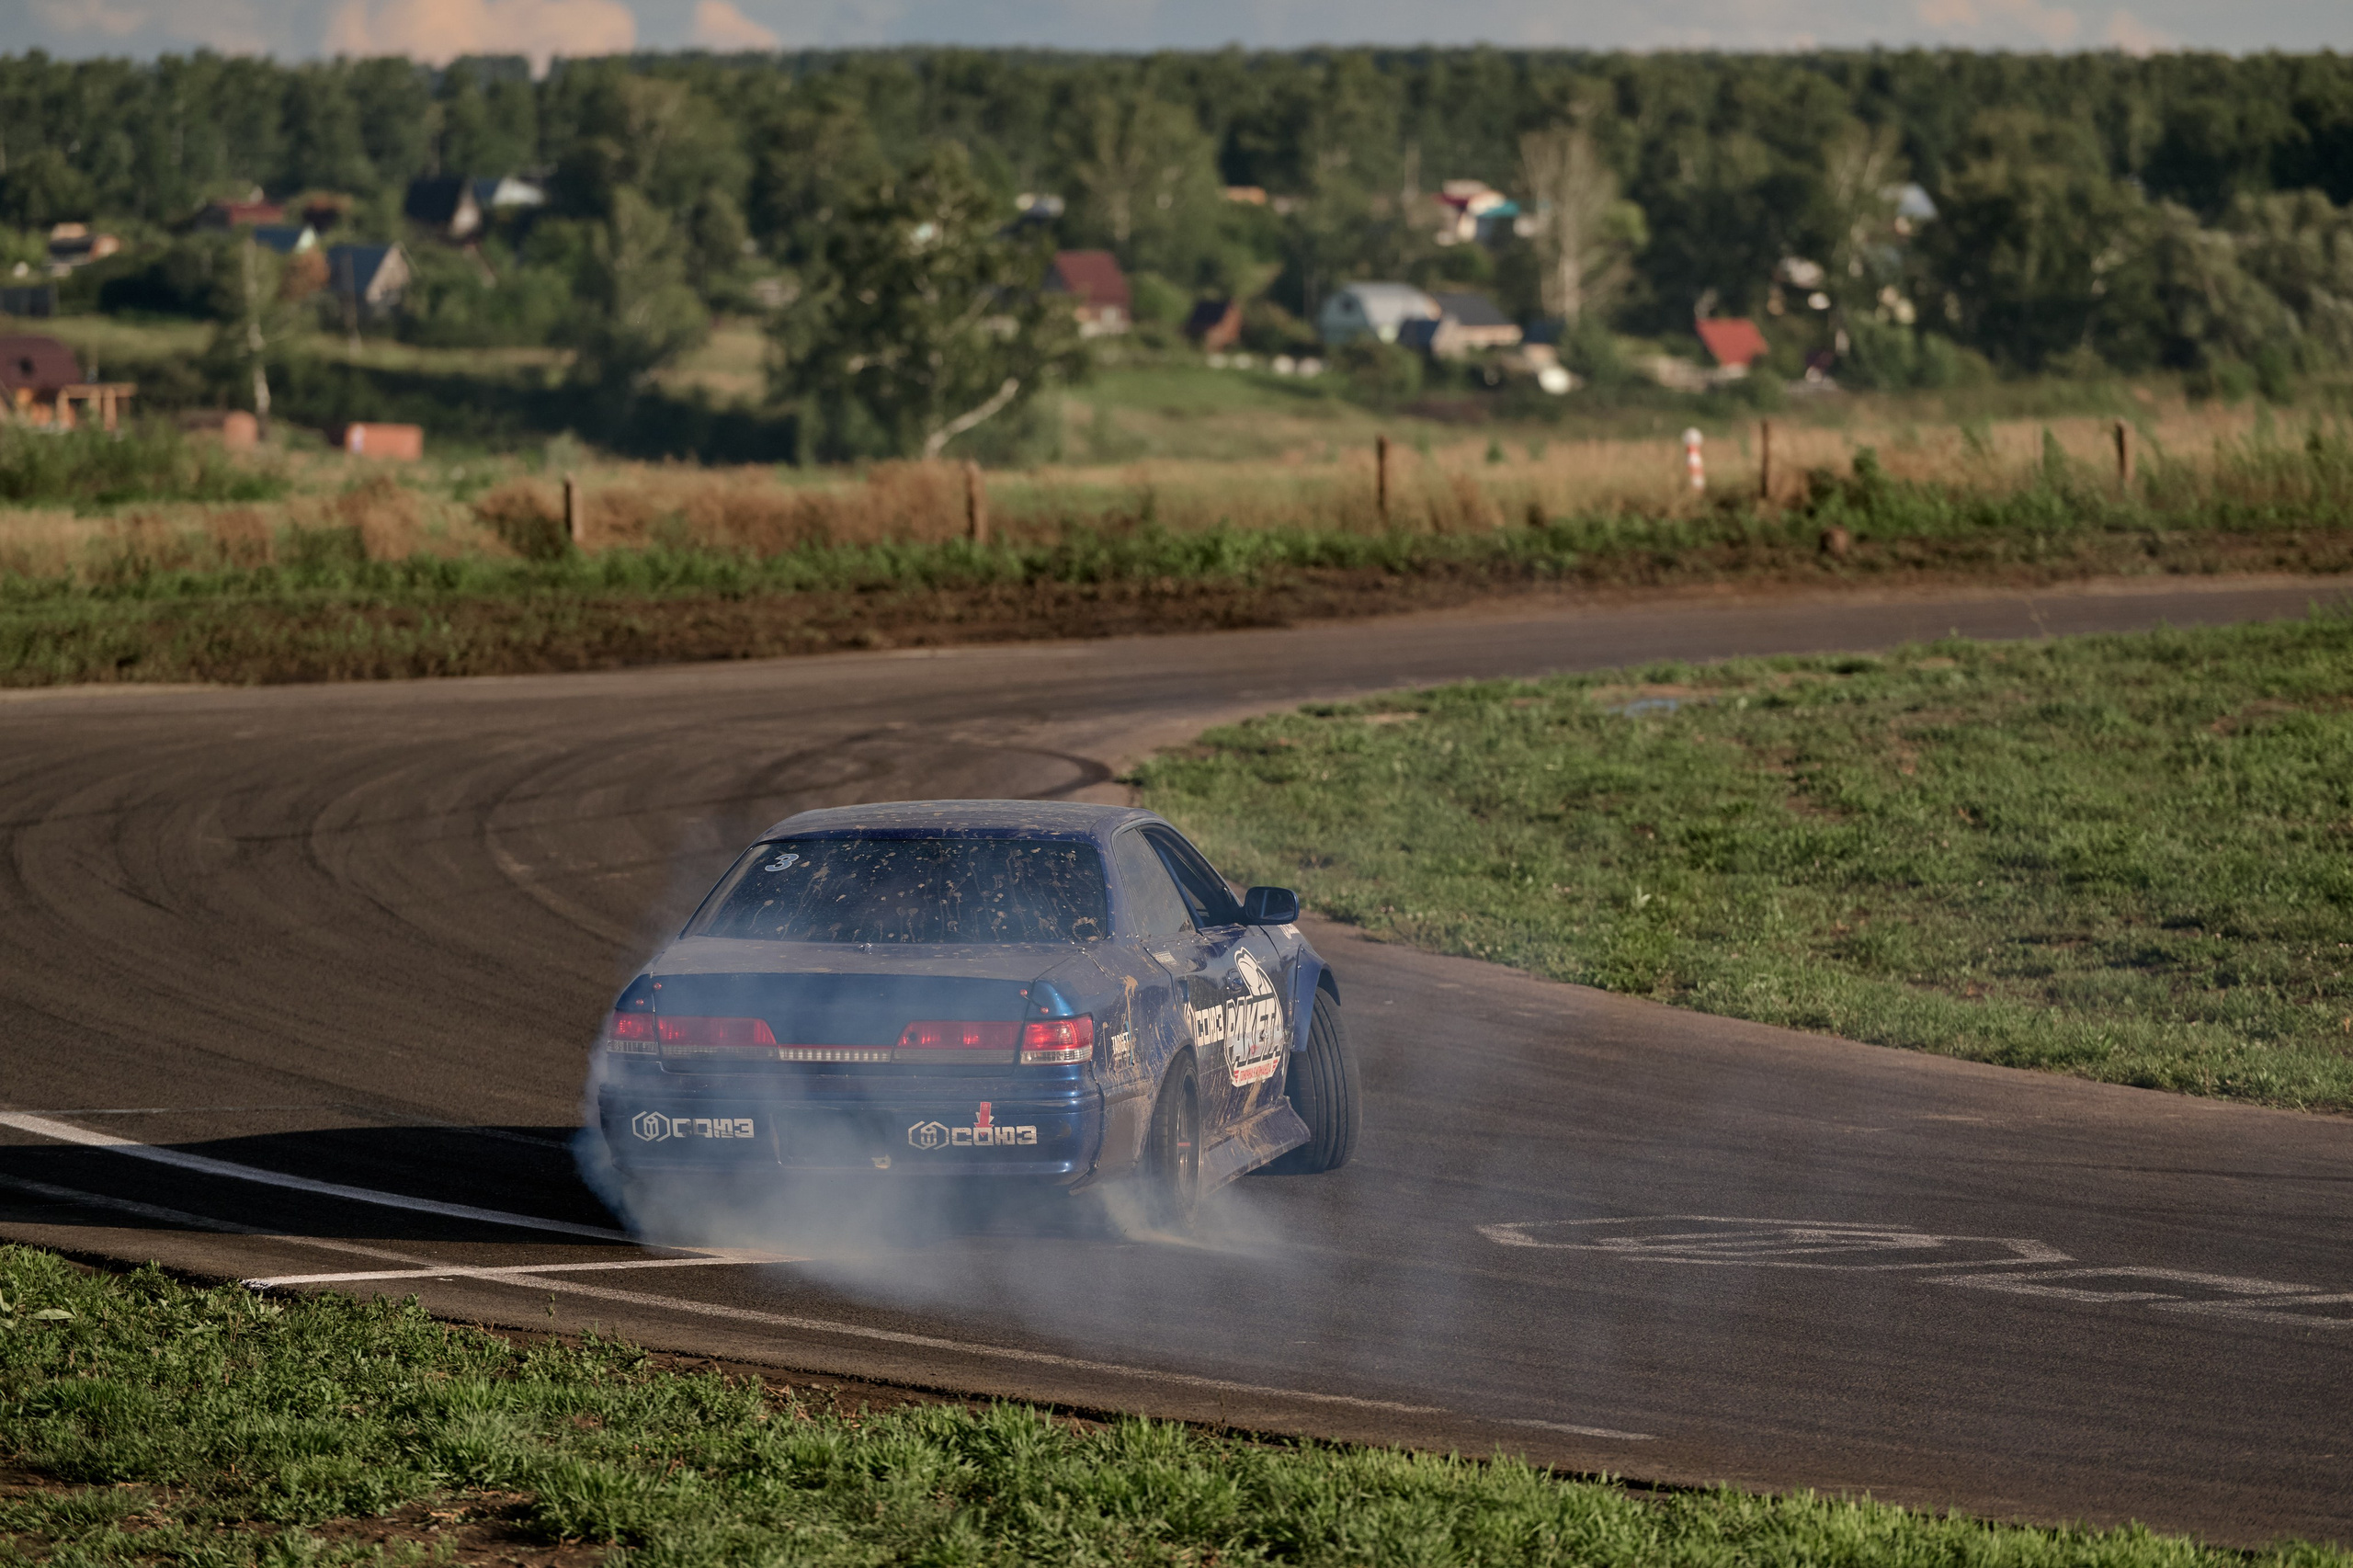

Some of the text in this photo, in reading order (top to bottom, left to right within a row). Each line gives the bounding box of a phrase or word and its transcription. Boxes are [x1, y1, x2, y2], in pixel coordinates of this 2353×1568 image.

[765, 853, 800, 872] 3
[1195, 1005, 1224, 1047] СОЮЗ
[1226, 996, 1283, 1064] РАКЕТА
[672, 1118, 754, 1139] СОЮЗ
[951, 1125, 1038, 1146] СОЮЗ
